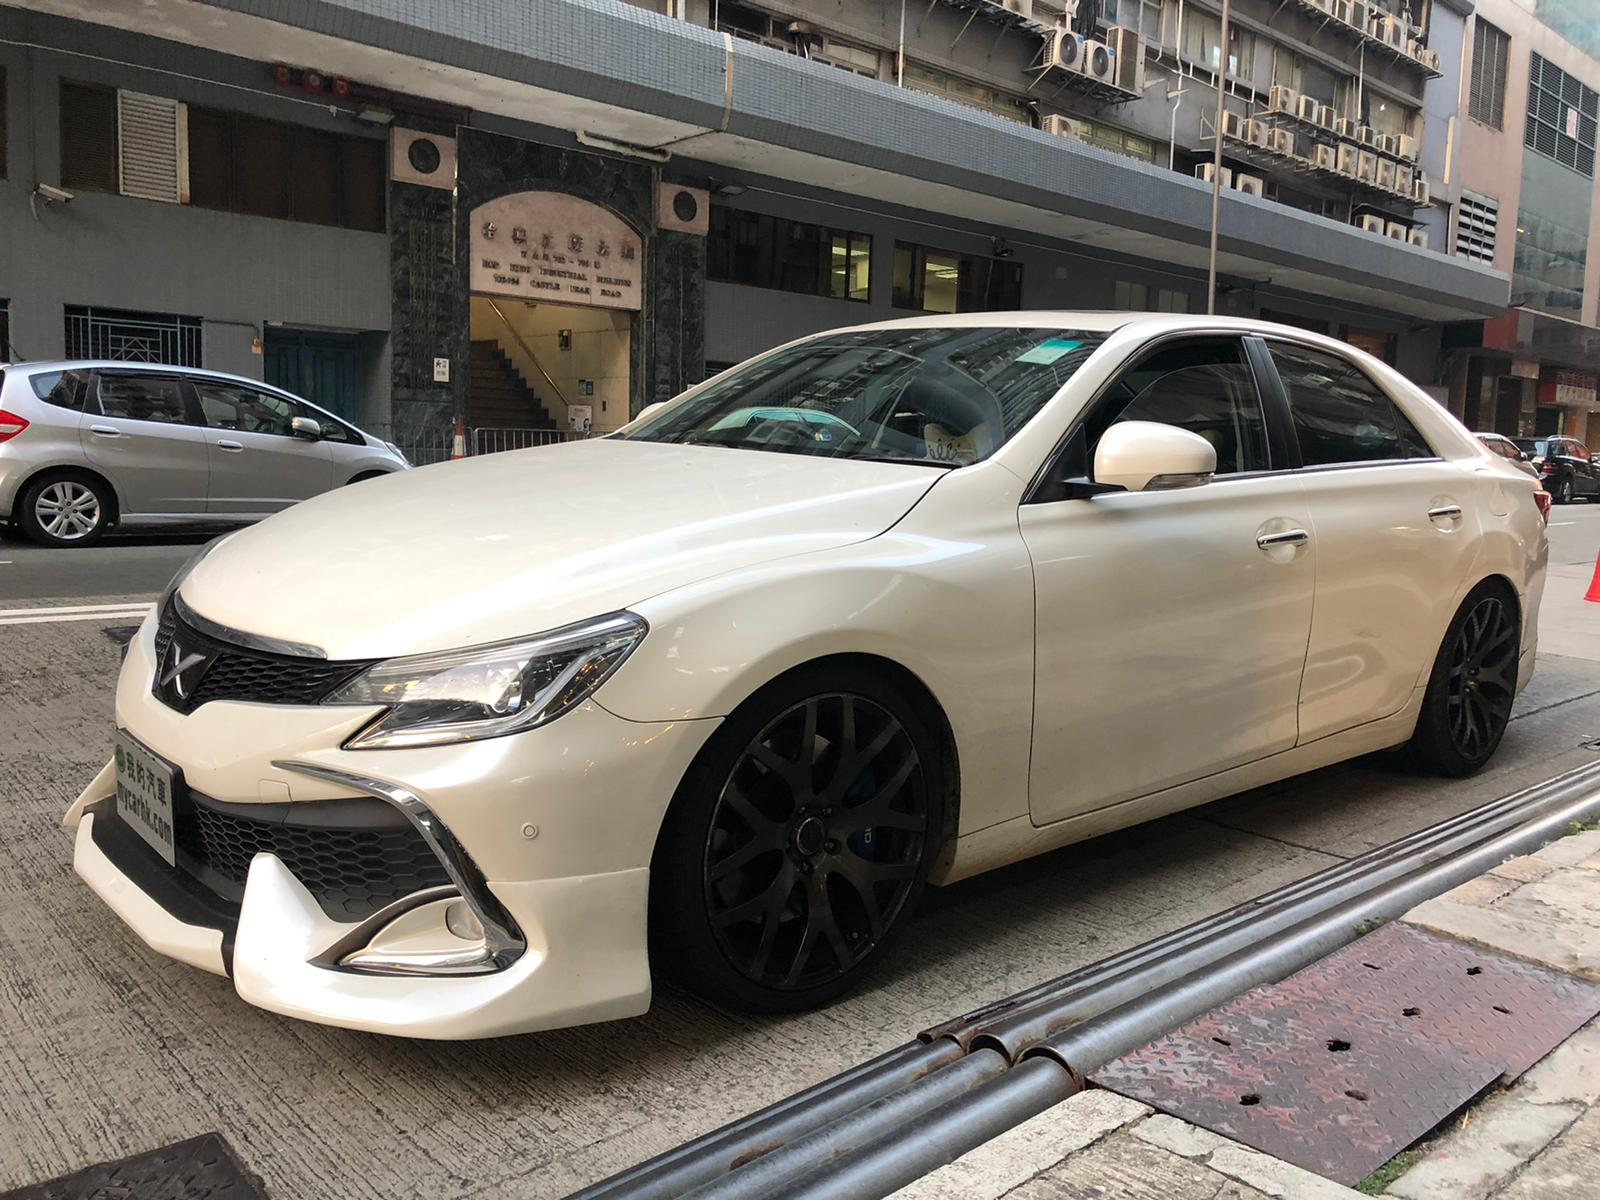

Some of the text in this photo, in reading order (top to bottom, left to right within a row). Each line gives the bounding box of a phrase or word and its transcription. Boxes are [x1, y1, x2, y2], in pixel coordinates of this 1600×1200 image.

[529, 279, 561, 291] CASTLE
[600, 288, 623, 298] ROAD
[125, 750, 167, 807] 我的汽車
[116, 779, 173, 848] mycarhk.com
